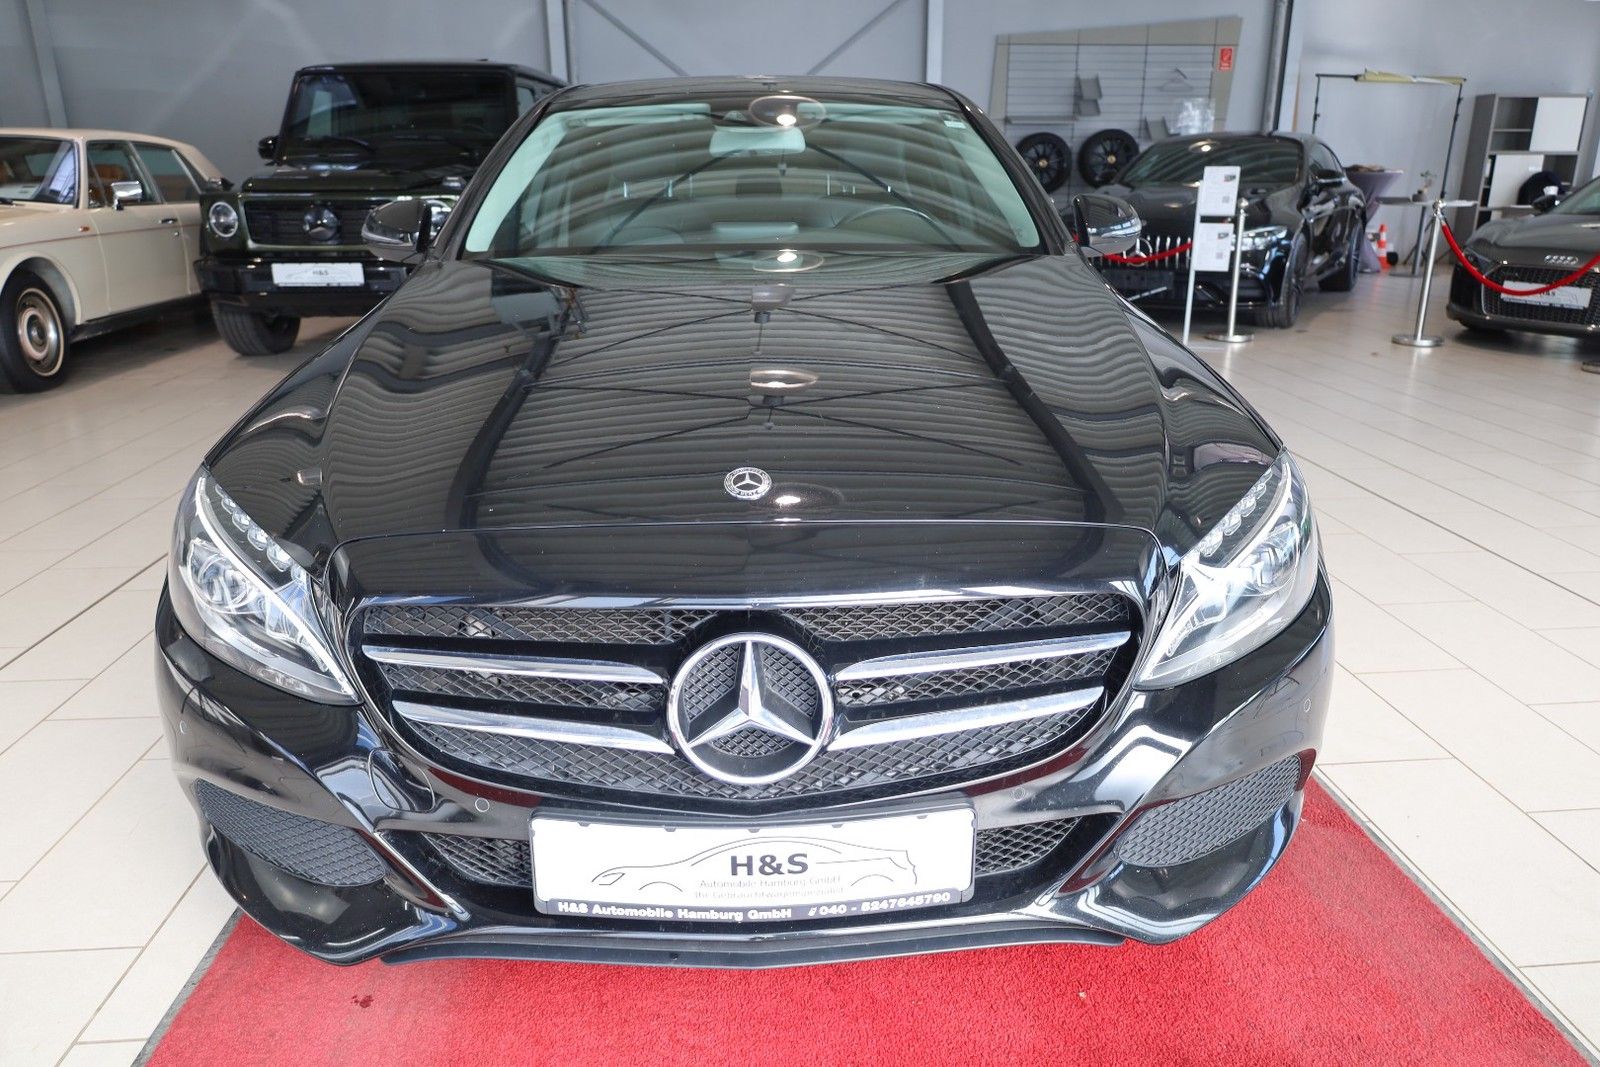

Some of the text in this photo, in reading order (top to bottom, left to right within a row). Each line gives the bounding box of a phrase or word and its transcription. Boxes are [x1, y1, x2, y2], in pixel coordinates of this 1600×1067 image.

[731, 853, 809, 876] H&S
[760, 878, 806, 888] Hamburg
[558, 901, 588, 914] H&S
[592, 904, 674, 919] Automobile
[678, 908, 744, 922] Hamburg
[748, 908, 792, 920] GmbH
[819, 904, 847, 916] 040
